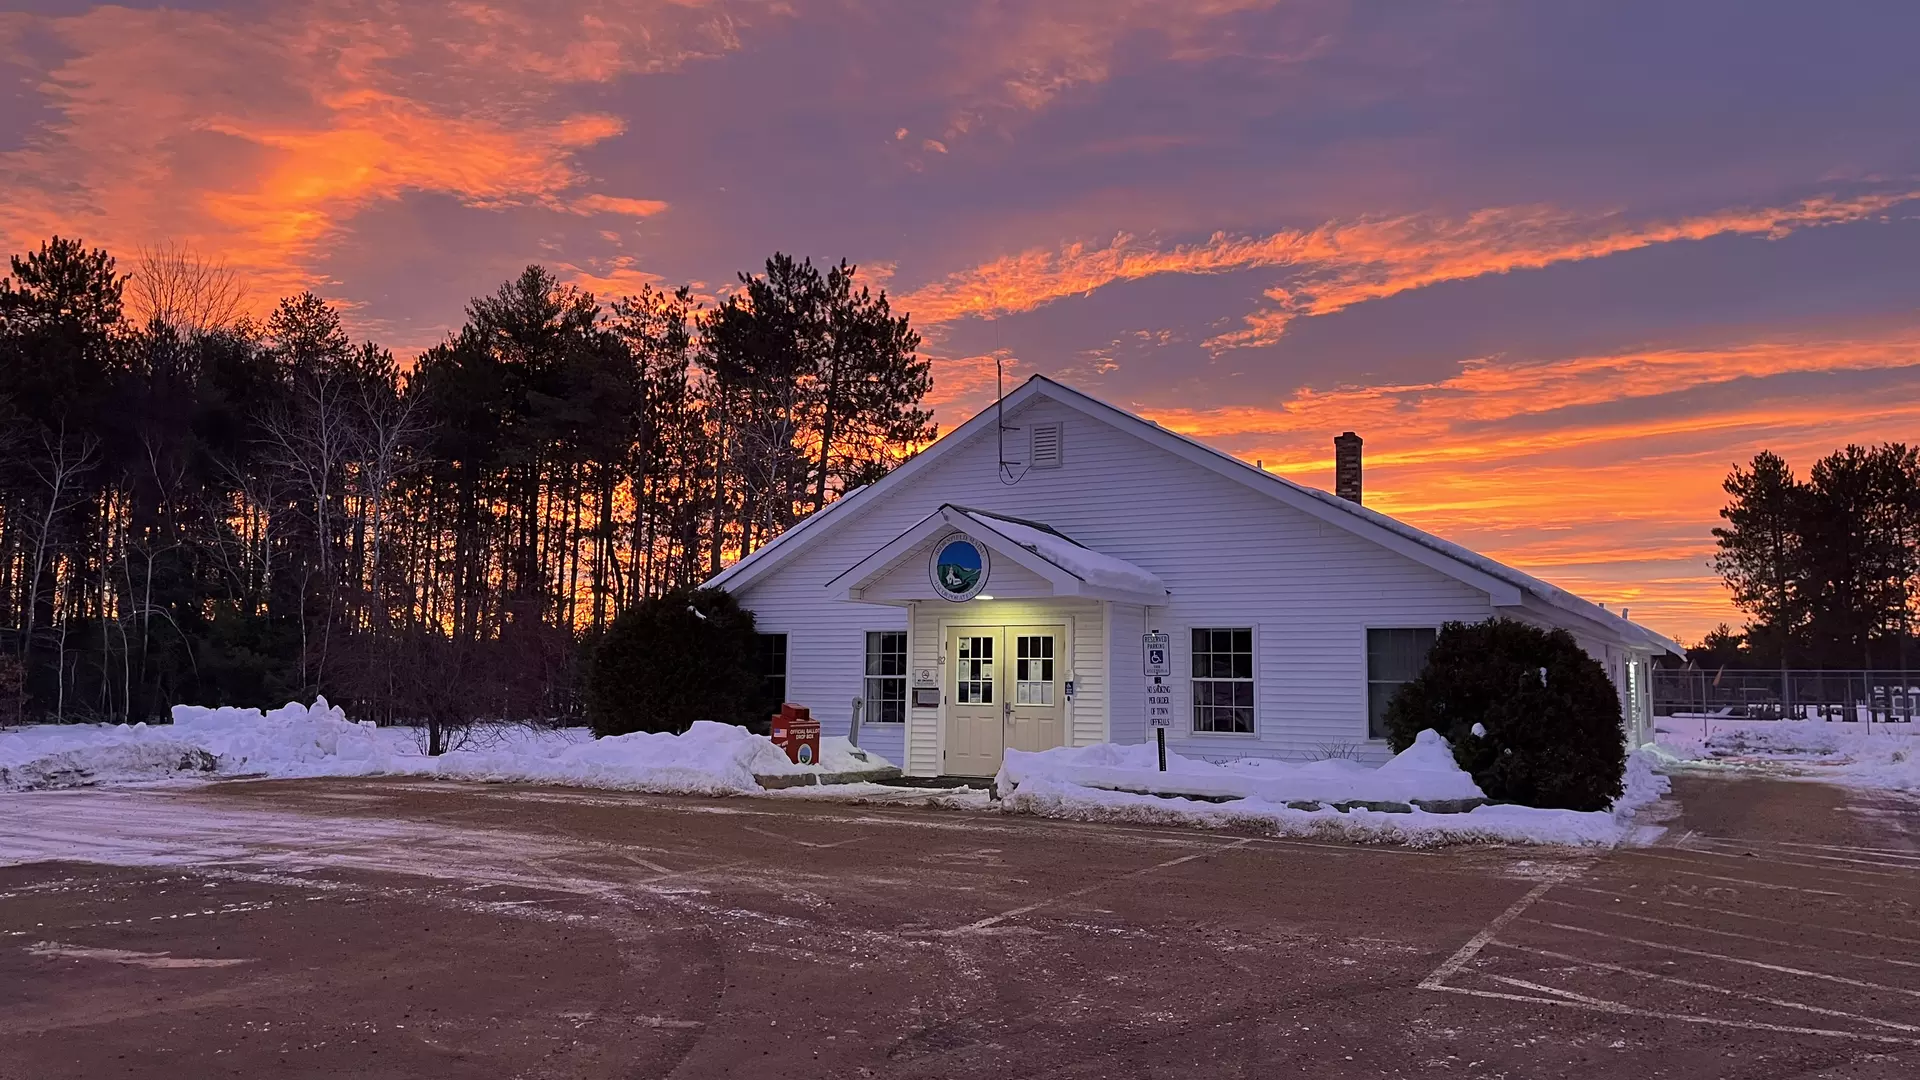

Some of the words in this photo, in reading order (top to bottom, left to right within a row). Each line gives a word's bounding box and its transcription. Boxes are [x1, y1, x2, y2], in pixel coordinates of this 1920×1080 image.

[1147, 685, 1152, 693] NO
[1153, 685, 1171, 694] SMOKING
[1156, 696, 1169, 704] ORDER
